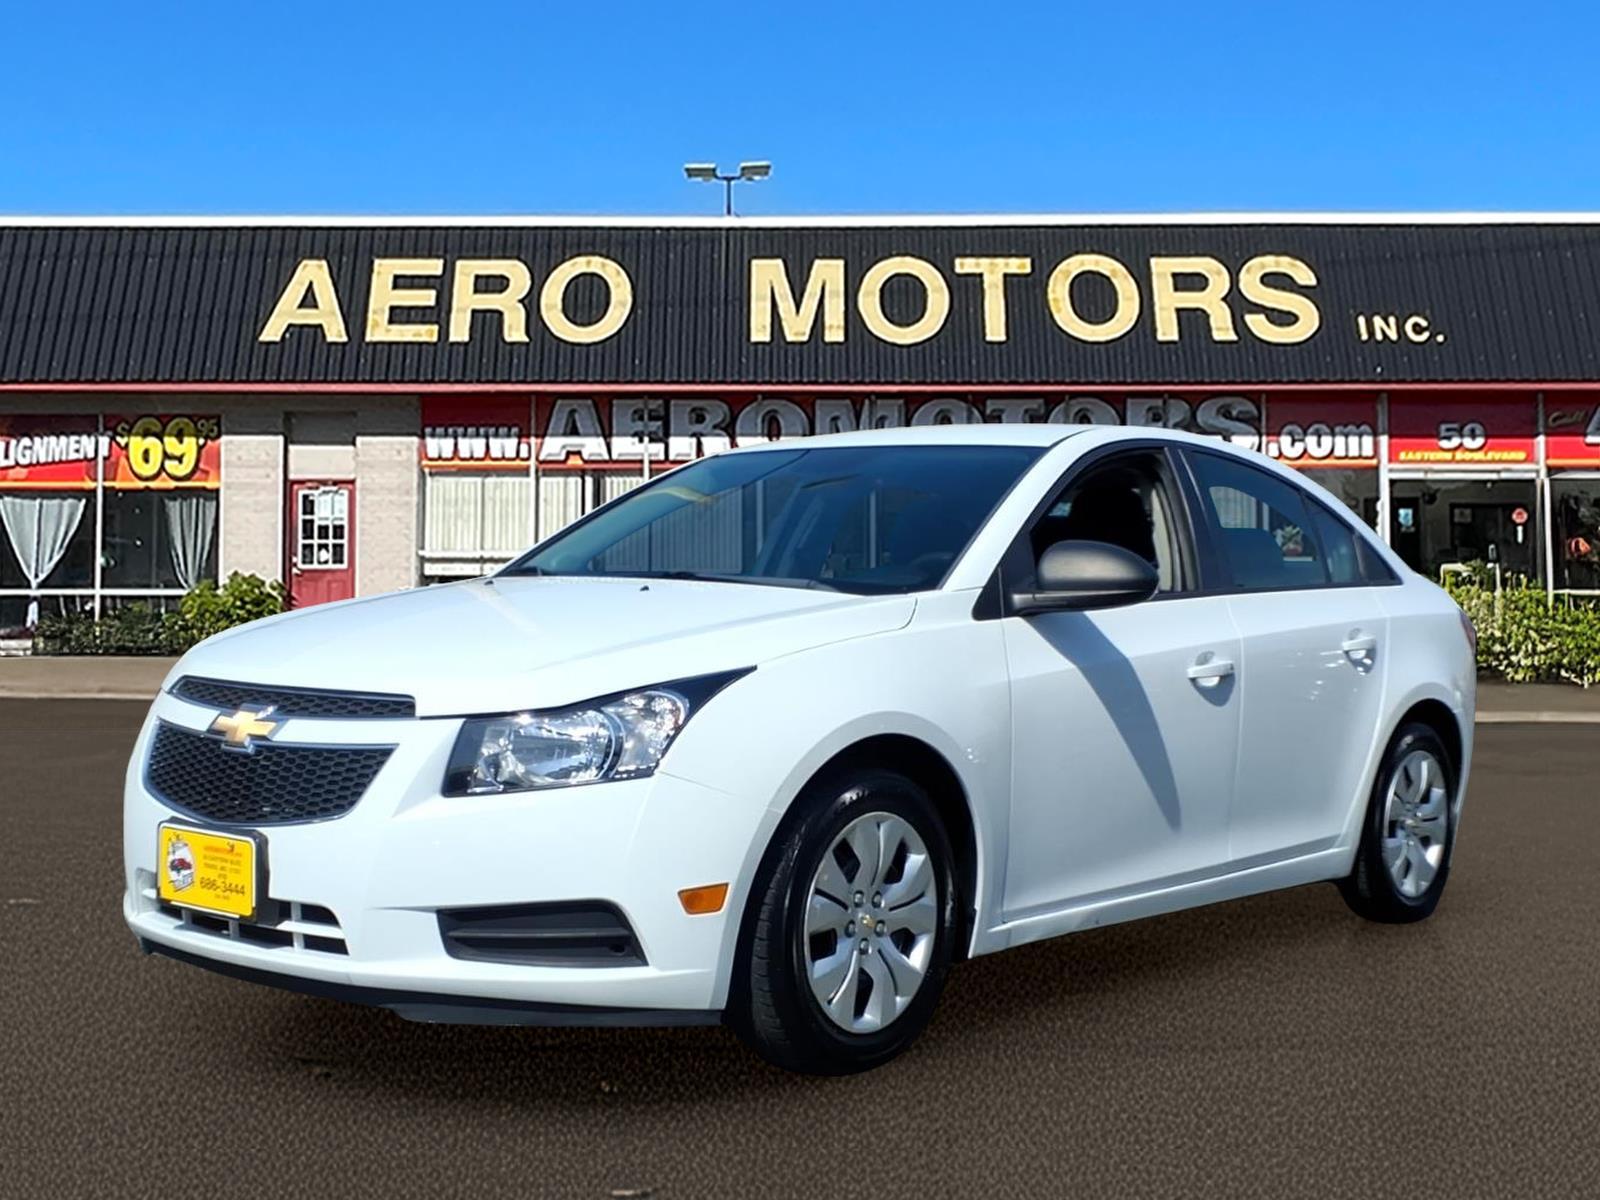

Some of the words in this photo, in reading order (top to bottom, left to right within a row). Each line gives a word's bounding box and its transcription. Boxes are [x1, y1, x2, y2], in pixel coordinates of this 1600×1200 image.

[259, 255, 634, 345] AERO
[750, 253, 1320, 346] MOTORS
[1356, 314, 1446, 343] INC.
[1437, 422, 1486, 450] 50
